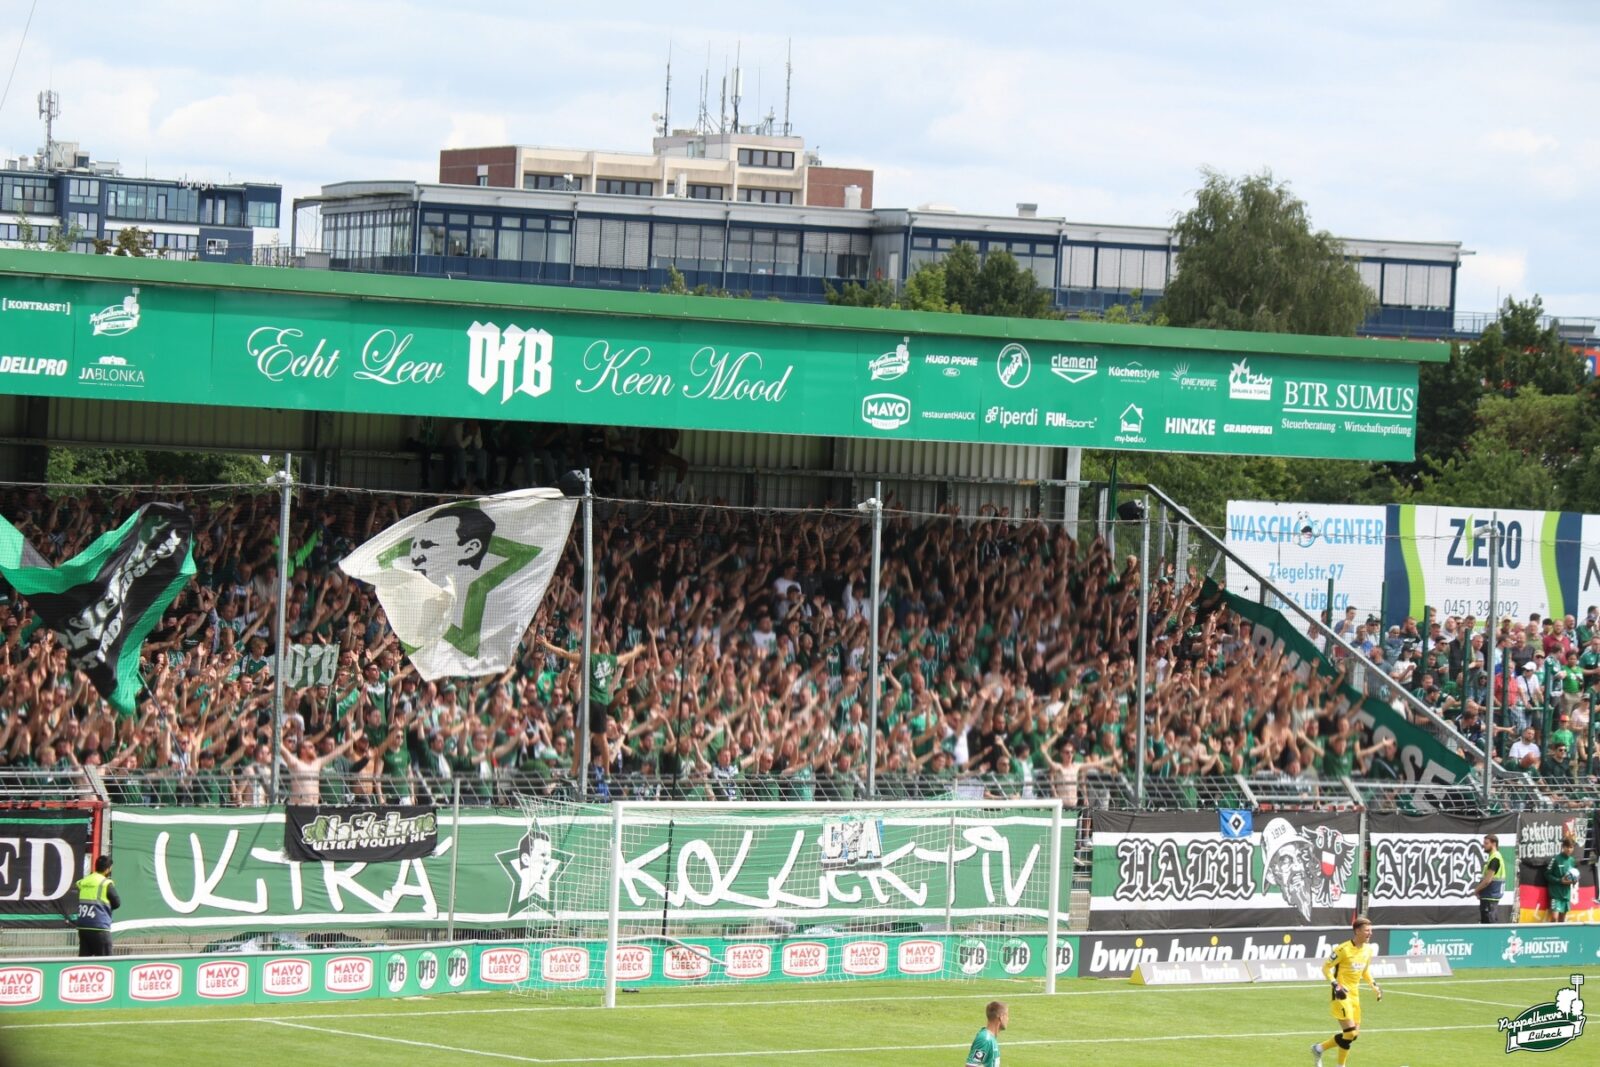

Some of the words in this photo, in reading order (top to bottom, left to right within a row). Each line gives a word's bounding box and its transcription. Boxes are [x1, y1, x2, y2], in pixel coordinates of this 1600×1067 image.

[0, 356, 68, 376] DELLPRO
[247, 326, 340, 382] Echt
[352, 328, 445, 386] Leev
[575, 340, 675, 397] Keen
[683, 346, 794, 402] Mood
[925, 354, 950, 365] HUGO
[951, 355, 978, 367] PFOHE
[1051, 354, 1099, 369] clement
[79, 367, 145, 383] JABLONKA
[1108, 365, 1160, 381] Küchenstyle
[1283, 381, 1329, 407] BTR
[1335, 383, 1414, 412] SUMUS
[867, 401, 906, 418] MAYO
[921, 411, 976, 421] restaurantHAUCK
[999, 406, 1039, 429] iperdi
[1165, 417, 1216, 435] HINZKE
[1223, 423, 1273, 435] GRABOWSKI
[1281, 418, 1336, 433] Steuerberatung
[1344, 421, 1412, 438] Wirtschaftsprüfung
[1230, 515, 1292, 543] WASCH
[1323, 517, 1384, 545] CENTER
[1304, 588, 1349, 611] LÜBCK
[1443, 598, 1471, 616] 0451
[1475, 600, 1519, 618] 39092
[313, 839, 356, 851] ULTRA
[360, 835, 406, 848] YOUTH
[790, 948, 821, 958] MAYO
[850, 946, 881, 957] MAYO
[905, 945, 936, 956] MAYO
[1427, 942, 1473, 956] HOLSTEN
[1524, 940, 1569, 954] HOLSTEN
[489, 953, 522, 965] MAYO
[549, 953, 582, 964] MAYO
[671, 950, 702, 961] MAYO
[732, 949, 764, 960] MAYO
[1089, 937, 1158, 973] bwin
[1167, 935, 1233, 963] bwin
[1242, 934, 1307, 961] bwin
[271, 964, 304, 976] MAYO
[333, 962, 365, 974] MAYO
[488, 964, 521, 974] LÜBECK
[549, 963, 581, 973] LÜBECK
[671, 960, 702, 970] LÜBECK
[1371, 959, 1397, 976] win
[69, 972, 105, 983] MAYO
[138, 969, 173, 981] MAYO
[206, 967, 240, 978] MAYO
[333, 973, 364, 983] LÜBECK
[138, 981, 172, 991] LÜBECK
[206, 978, 239, 989] LÜBECK
[271, 975, 303, 986] LÜBECK
[68, 983, 104, 993] LÜBECK
